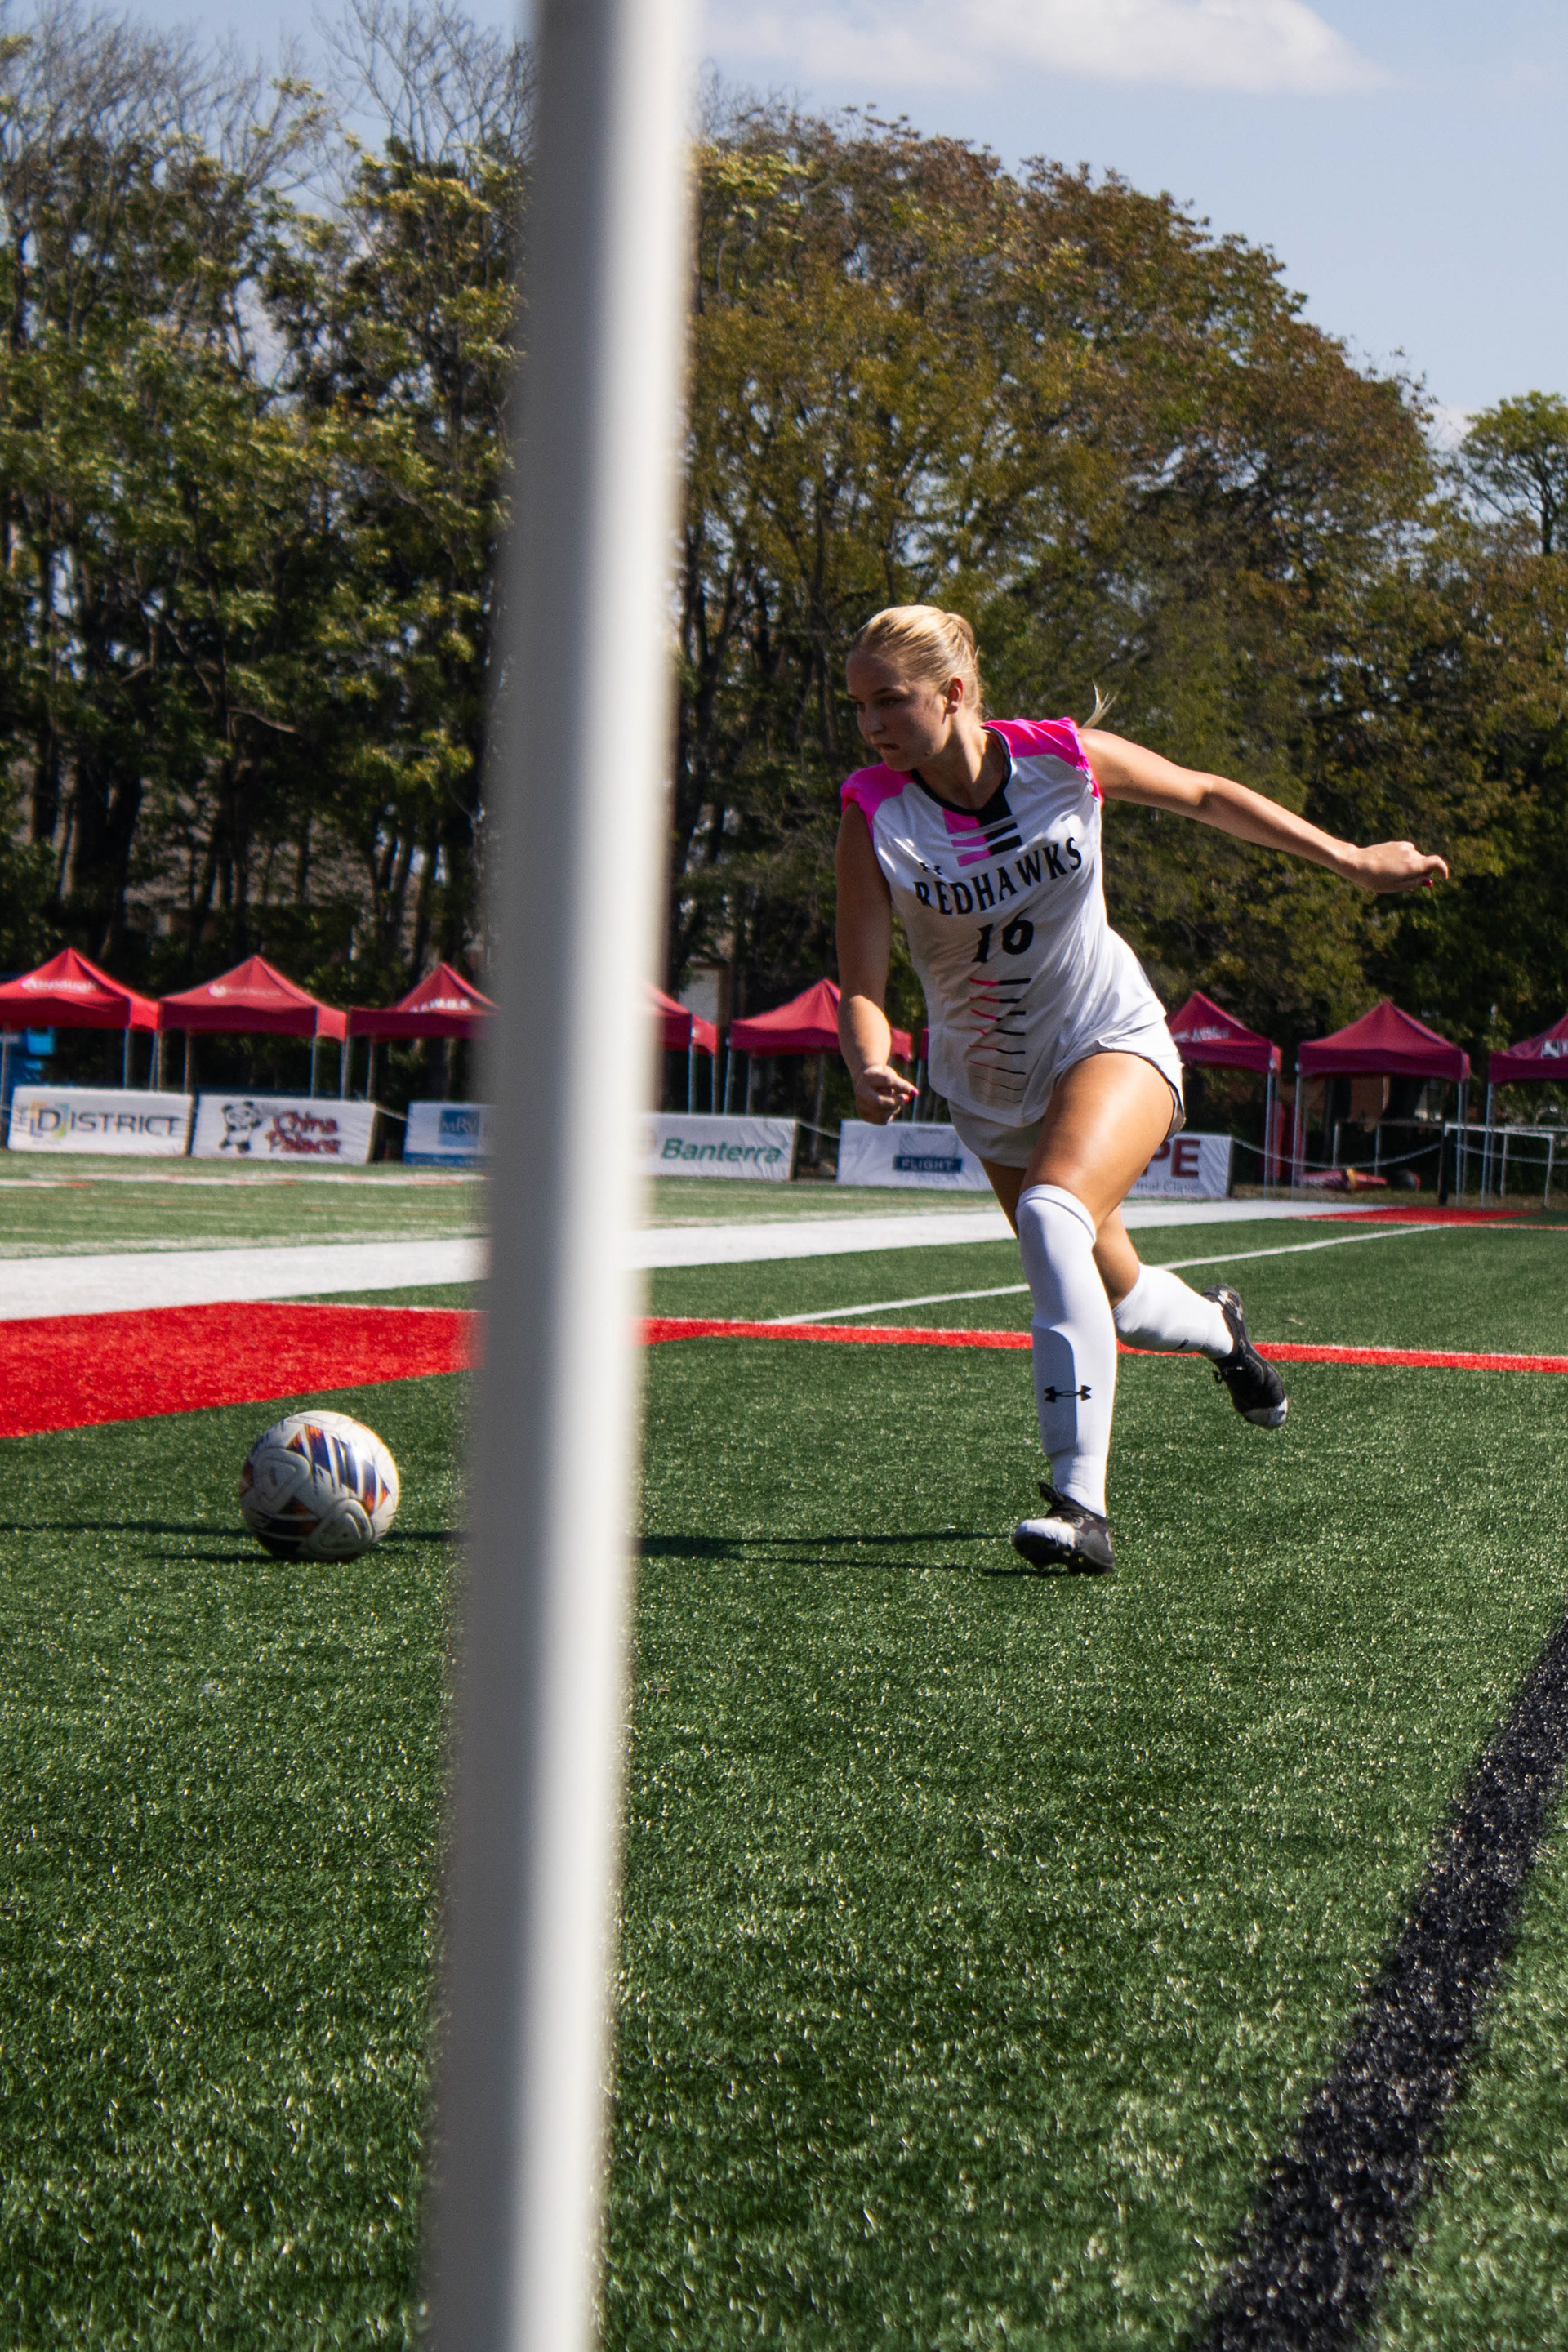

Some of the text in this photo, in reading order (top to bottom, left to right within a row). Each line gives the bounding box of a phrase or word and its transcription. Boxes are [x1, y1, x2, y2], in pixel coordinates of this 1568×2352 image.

[913, 836, 1082, 915] REDHAWKS
[37, 1108, 182, 1137] DISTRICT
[271, 1111, 339, 1134] China
[264, 1130, 341, 1154] Palace
[661, 1137, 782, 1164] Banterra
[901, 1158, 954, 1171] FLIGHT
